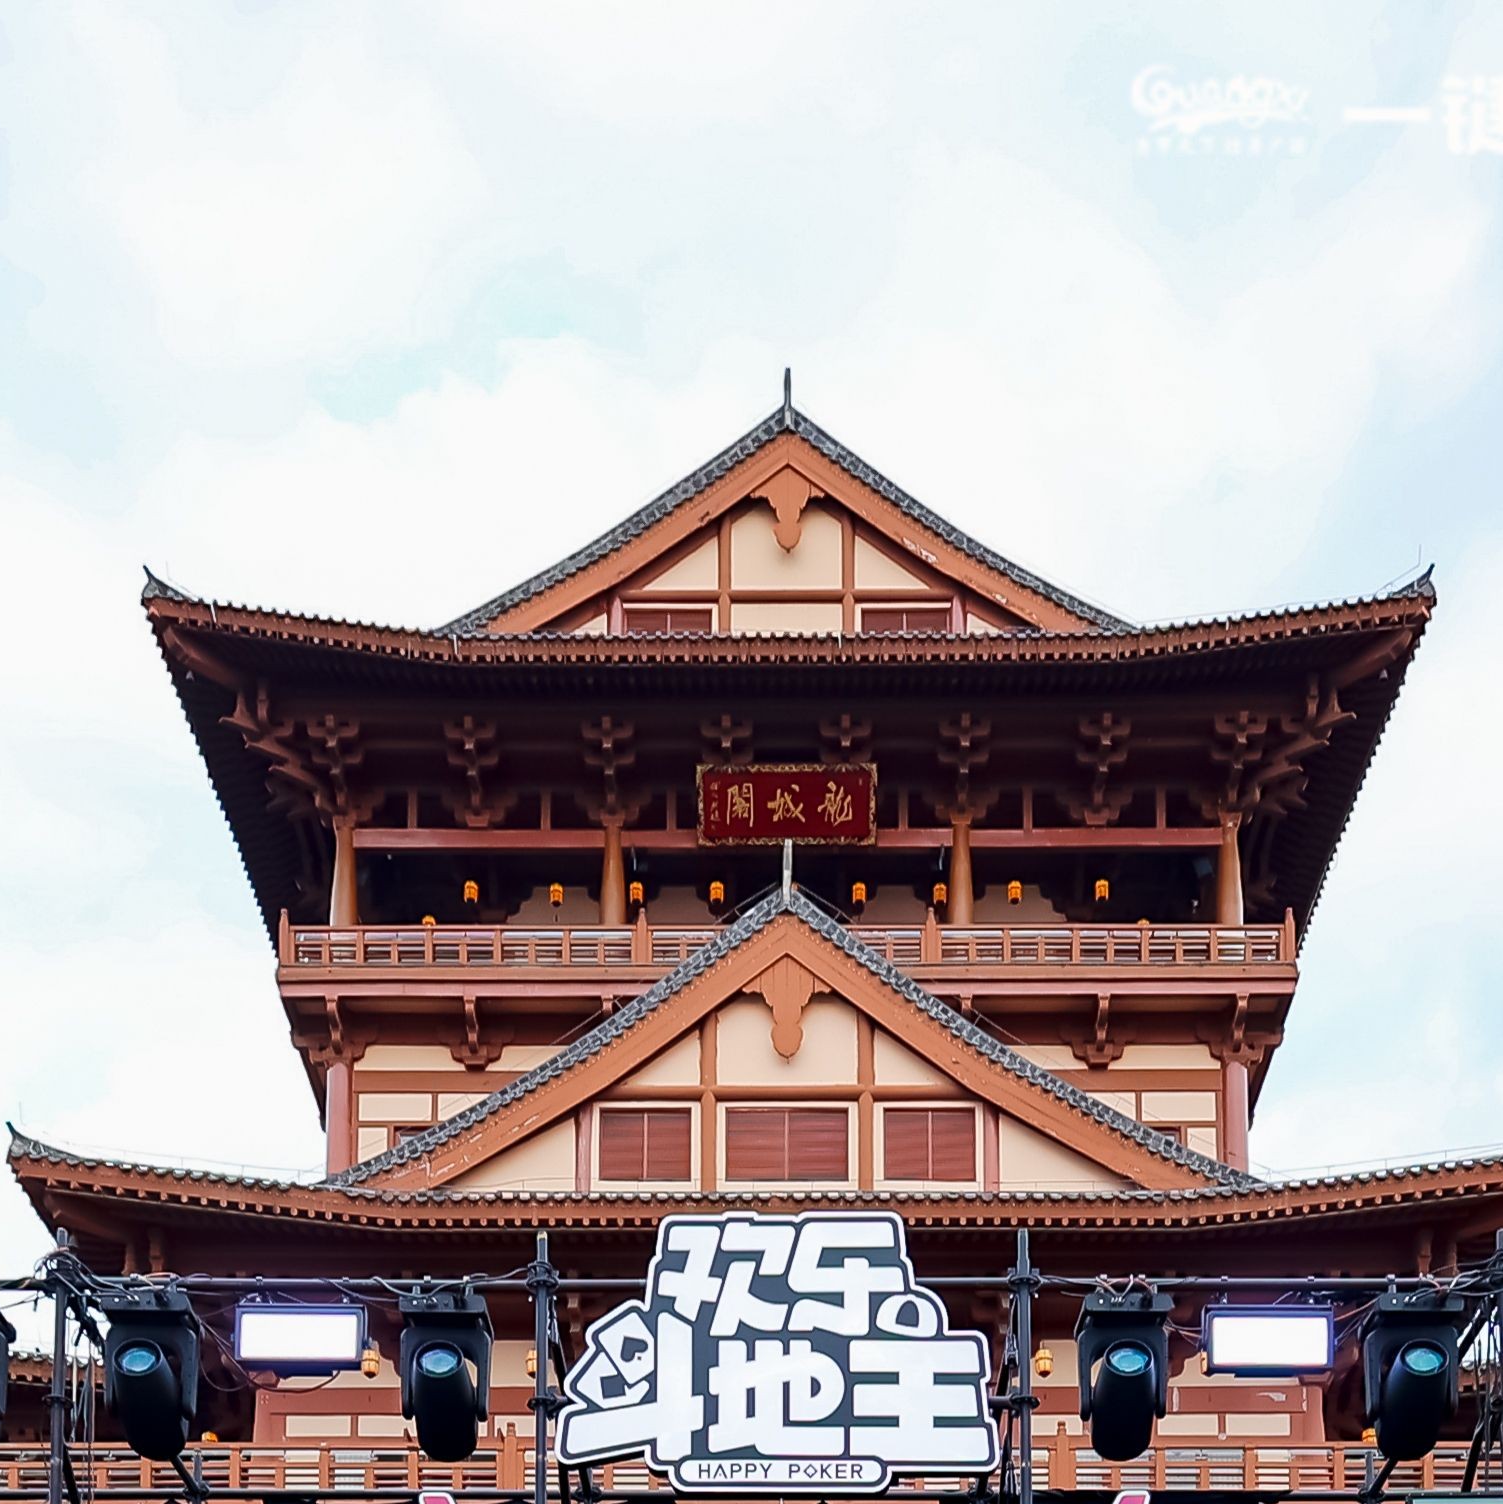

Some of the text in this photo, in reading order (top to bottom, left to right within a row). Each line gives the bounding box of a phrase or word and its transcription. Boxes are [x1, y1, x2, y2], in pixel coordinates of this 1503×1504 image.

[657, 1221, 906, 1337] 欢乐
[565, 1311, 990, 1462] 斗地主
[697, 1462, 864, 1480] HAPPY POKER
